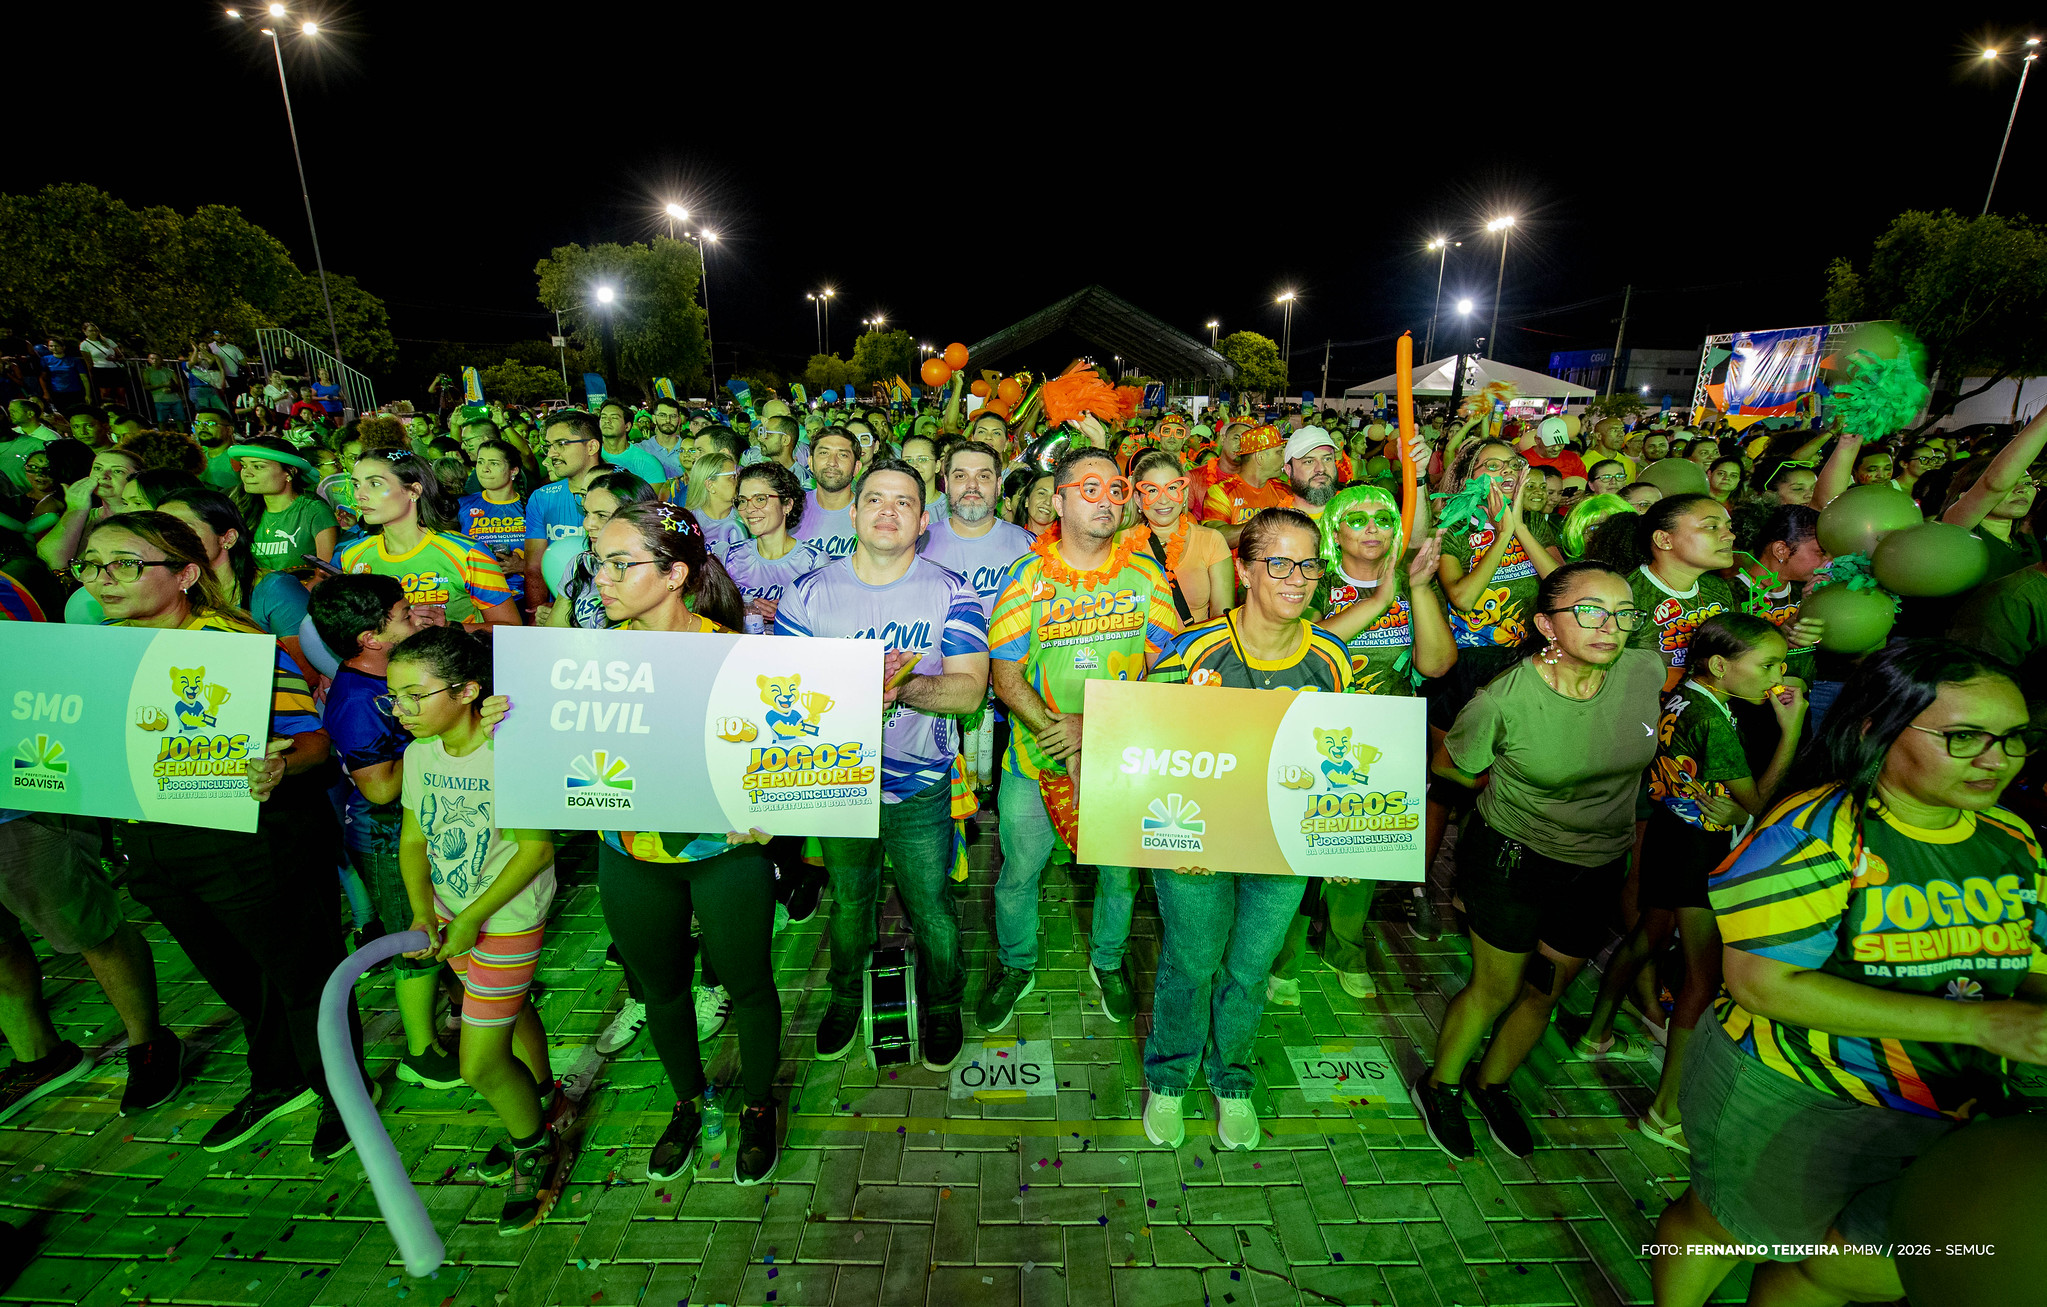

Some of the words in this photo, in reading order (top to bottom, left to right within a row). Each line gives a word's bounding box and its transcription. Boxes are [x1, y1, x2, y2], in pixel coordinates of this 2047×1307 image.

[1590, 353, 1606, 362] CGU
[471, 517, 524, 528] JOGOS
[1040, 589, 1136, 626] JOGOS
[1130, 595, 1145, 603] DOS
[1037, 611, 1144, 642] SERVIDORES
[1053, 636, 1093, 647] PREFEITURA
[1106, 631, 1121, 640] BOA
[1123, 630, 1140, 638] VISTA
[551, 659, 655, 693] CASA
[11, 691, 83, 724] SMO
[551, 700, 651, 734] CIVIL
[158, 734, 250, 762] JOGOS
[747, 742, 863, 774] JOGOS
[153, 760, 249, 777] SERVIDORE
[1119, 746, 1237, 779] SMSOP
[168, 780, 198, 790] JOGOS
[199, 778, 249, 790] INCLUSIVOS
[424, 772, 492, 792] SUMMER
[743, 766, 875, 790] SERVIDORES
[749, 805, 761, 813] DA
[764, 802, 813, 811] PREFEITURA
[815, 801, 826, 809] DE
[828, 799, 846, 807] BOA
[848, 798, 873, 806] VISTA
[763, 791, 800, 803] JOGOS
[802, 787, 867, 799] INCLUSIVOS
[1304, 791, 1407, 819] JOGOS
[1300, 813, 1419, 834] SERVIDORES
[1318, 836, 1352, 846] JOGOS
[1353, 833, 1412, 844] INCLUSIVOS
[1320, 847, 1364, 855] PREFEITURA
[1395, 843, 1417, 851] VISTA
[1861, 874, 2024, 934] JOGOS
[1864, 965, 1893, 977] DA
[1895, 958, 1974, 977] PREFEITURA
[1976, 957, 1998, 970] DE
[2000, 956, 2028, 970] BOA
[961, 1064, 1041, 1087] SMO
[1303, 1061, 1385, 1080] SMCT
